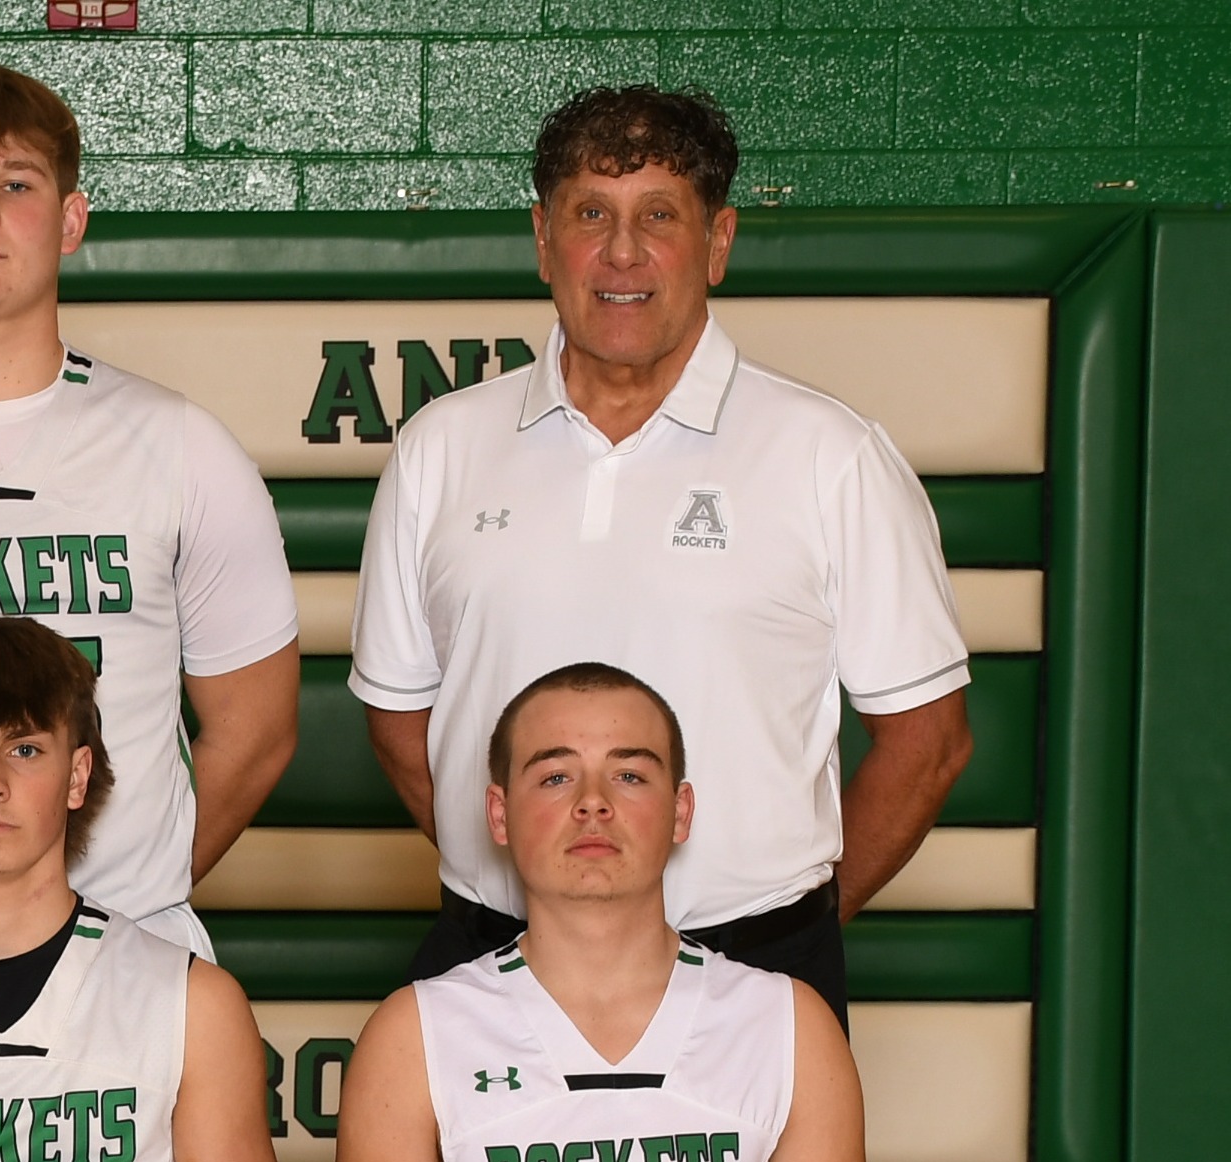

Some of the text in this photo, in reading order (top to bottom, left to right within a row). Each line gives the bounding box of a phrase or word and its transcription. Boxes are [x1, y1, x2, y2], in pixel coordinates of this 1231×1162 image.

[302, 338, 536, 444] AN
[674, 490, 727, 537] A
[672, 535, 726, 550] ROCKETS
